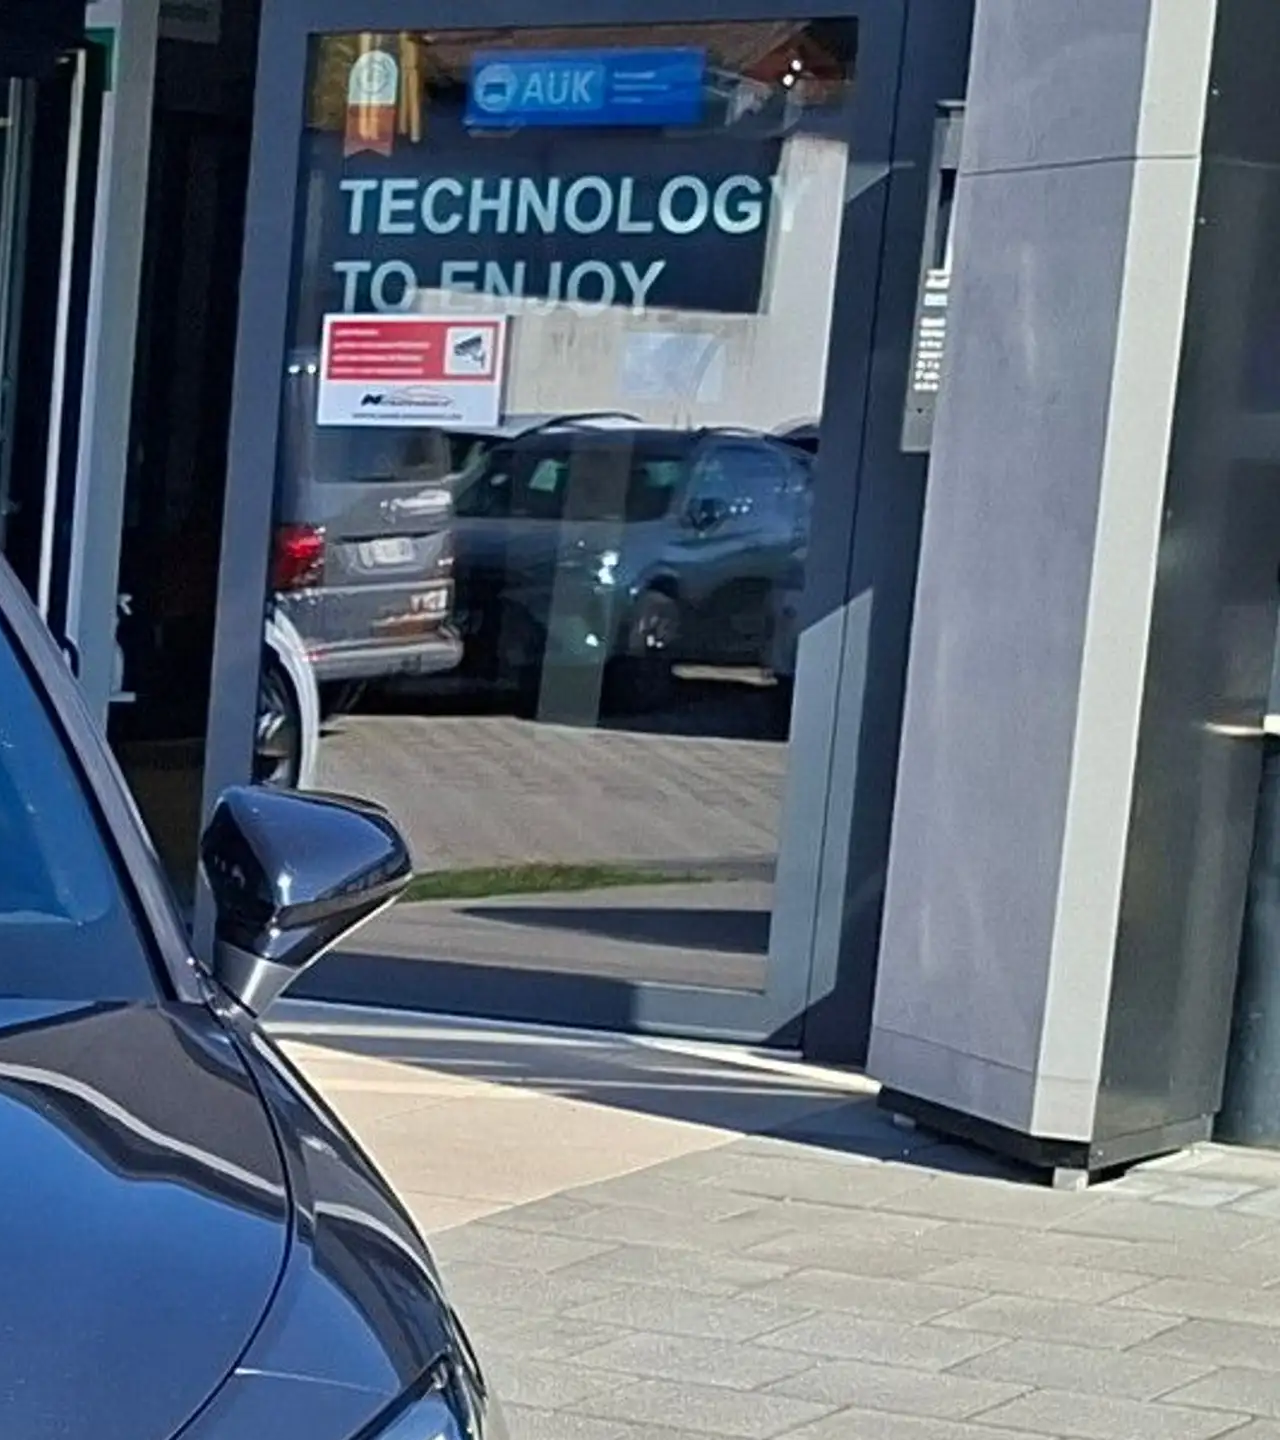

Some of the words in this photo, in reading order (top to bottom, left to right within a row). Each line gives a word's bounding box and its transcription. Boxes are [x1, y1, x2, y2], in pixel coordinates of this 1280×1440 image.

[340, 174, 811, 236] TECHNOLOGY
[334, 259, 415, 315] TO
[440, 260, 666, 316] ENJOY
